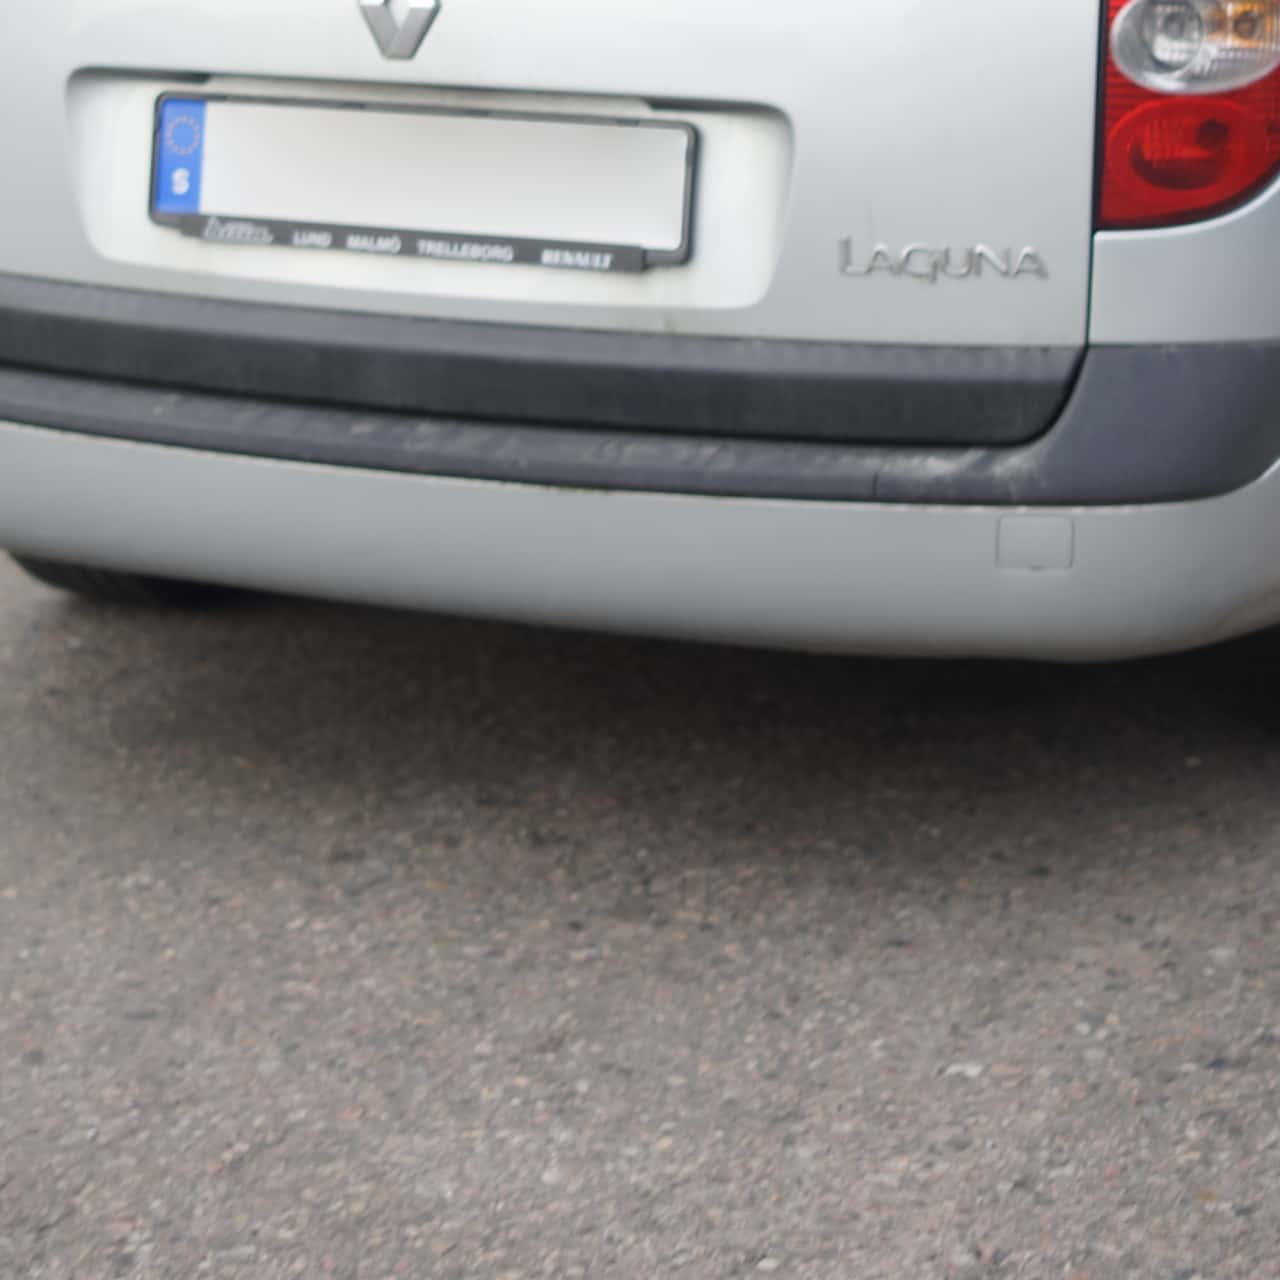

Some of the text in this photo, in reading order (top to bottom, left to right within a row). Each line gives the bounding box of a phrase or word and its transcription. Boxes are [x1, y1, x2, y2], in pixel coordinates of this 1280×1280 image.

[171, 167, 190, 195] S
[417, 238, 515, 262] TRELLEBORG
[540, 247, 613, 269] RENAULT
[838, 235, 1051, 284] LAGUNA
